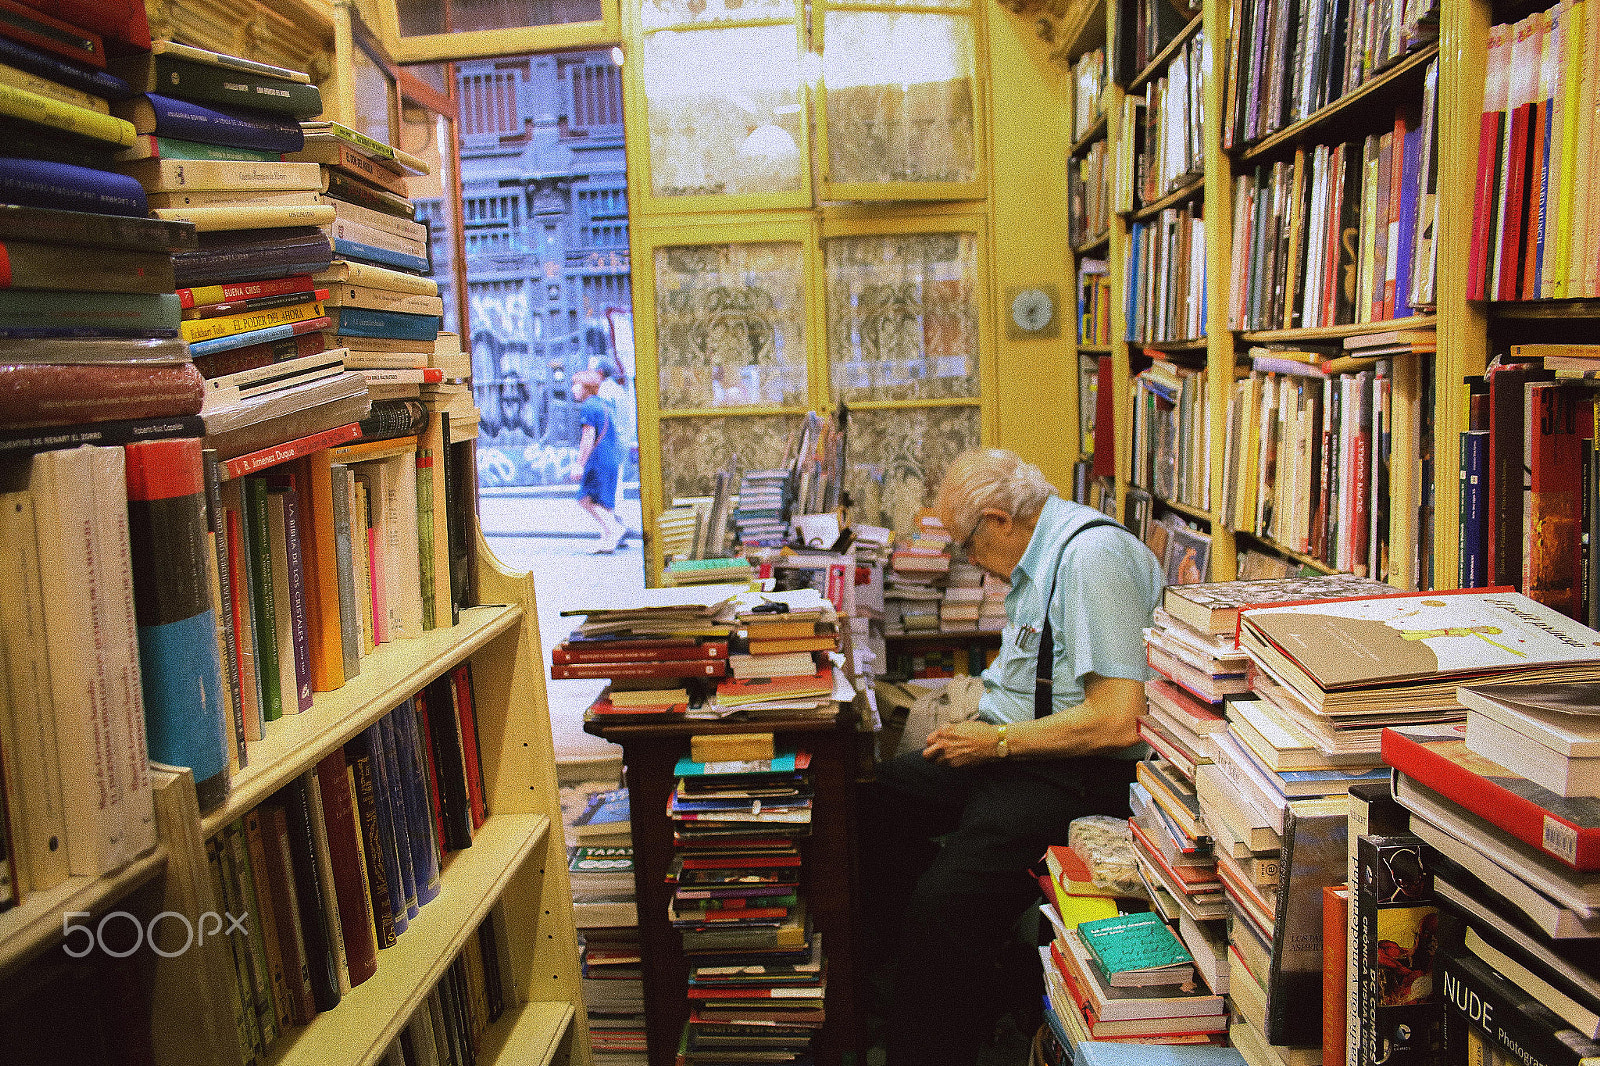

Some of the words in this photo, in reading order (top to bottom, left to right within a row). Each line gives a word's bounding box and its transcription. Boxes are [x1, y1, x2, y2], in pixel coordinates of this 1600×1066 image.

[224, 286, 244, 298] BUENA
[245, 284, 261, 295] CRISIS
[233, 319, 242, 332] EL
[242, 315, 266, 331] PODER
[267, 314, 280, 326] DEL
[280, 308, 304, 324] AHORA
[251, 452, 275, 469] Jiménez
[276, 446, 295, 462] Duque
[289, 503, 295, 516] LA
[292, 552, 298, 565] DE
[295, 591, 303, 642] CRISTALES
[1350, 856, 1359, 967] modernidad
[1370, 969, 1376, 993] DC
[1443, 970, 1494, 1034] NUDE
